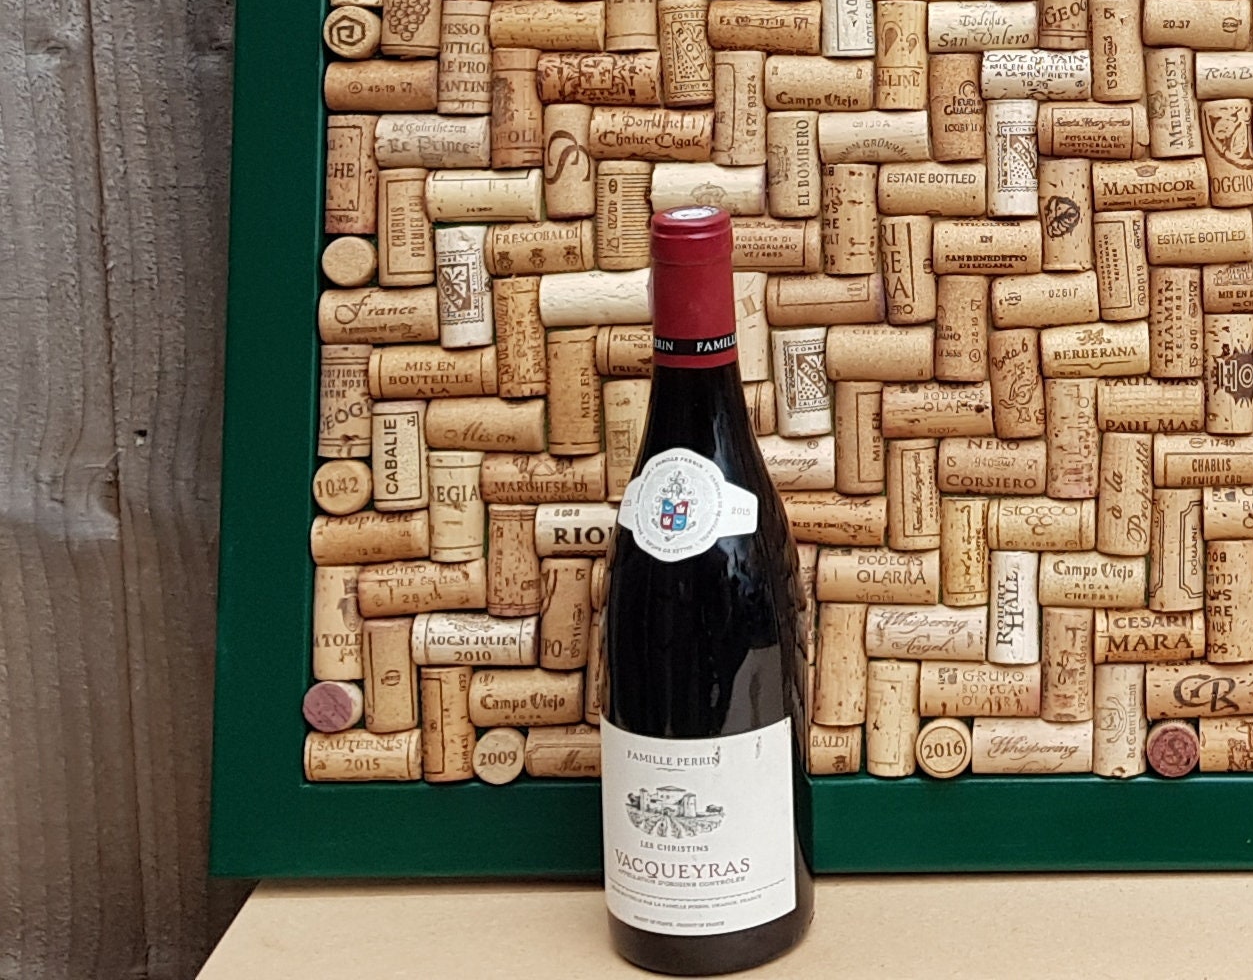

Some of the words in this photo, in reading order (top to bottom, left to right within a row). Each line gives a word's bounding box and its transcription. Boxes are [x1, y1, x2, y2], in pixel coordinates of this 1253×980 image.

[1167, 58, 1183, 148] MEERLUST
[886, 172, 925, 184] ESTATE
[927, 172, 977, 185] BOTTLED
[1102, 179, 1195, 196] MANINCOR
[495, 229, 580, 245] FRESCOBALDI
[1156, 233, 1195, 246] ESTATE
[1197, 230, 1246, 245] BOTTLED
[334, 296, 418, 325] France
[1163, 279, 1174, 368] TRAMIN
[1053, 345, 1138, 361] BERBERANA
[404, 360, 434, 372] MIS
[436, 360, 456, 372] EN
[388, 373, 473, 385] BOUTEILLE
[967, 439, 1020, 450] NERO
[1210, 438, 1236, 447] 17-40
[384, 417, 398, 495] CABALIE
[1191, 458, 1232, 472] CHABLIS
[945, 473, 1037, 489] CORSIERO
[730, 506, 751, 517] 2015
[856, 569, 928, 585] OLARRA
[1052, 559, 1097, 577] Campo
[1100, 560, 1135, 581] Viejo
[875, 611, 969, 637] Whispering
[1113, 616, 1187, 630] CESARI
[1105, 632, 1193, 653] MARA
[454, 651, 492, 662] 2010
[962, 669, 1025, 683] GRUPO
[480, 695, 527, 711] Campo
[529, 693, 566, 712] Viejo
[923, 739, 963, 759] 2016
[344, 758, 381, 771] 2015
[477, 750, 518, 766] 2009
[626, 749, 673, 765] FAMILLE
[677, 754, 720, 766] PERRIN
[640, 840, 654, 848] LES
[657, 844, 709, 852] CHRISTINS
[614, 848, 751, 879] VACQUEYRAS
